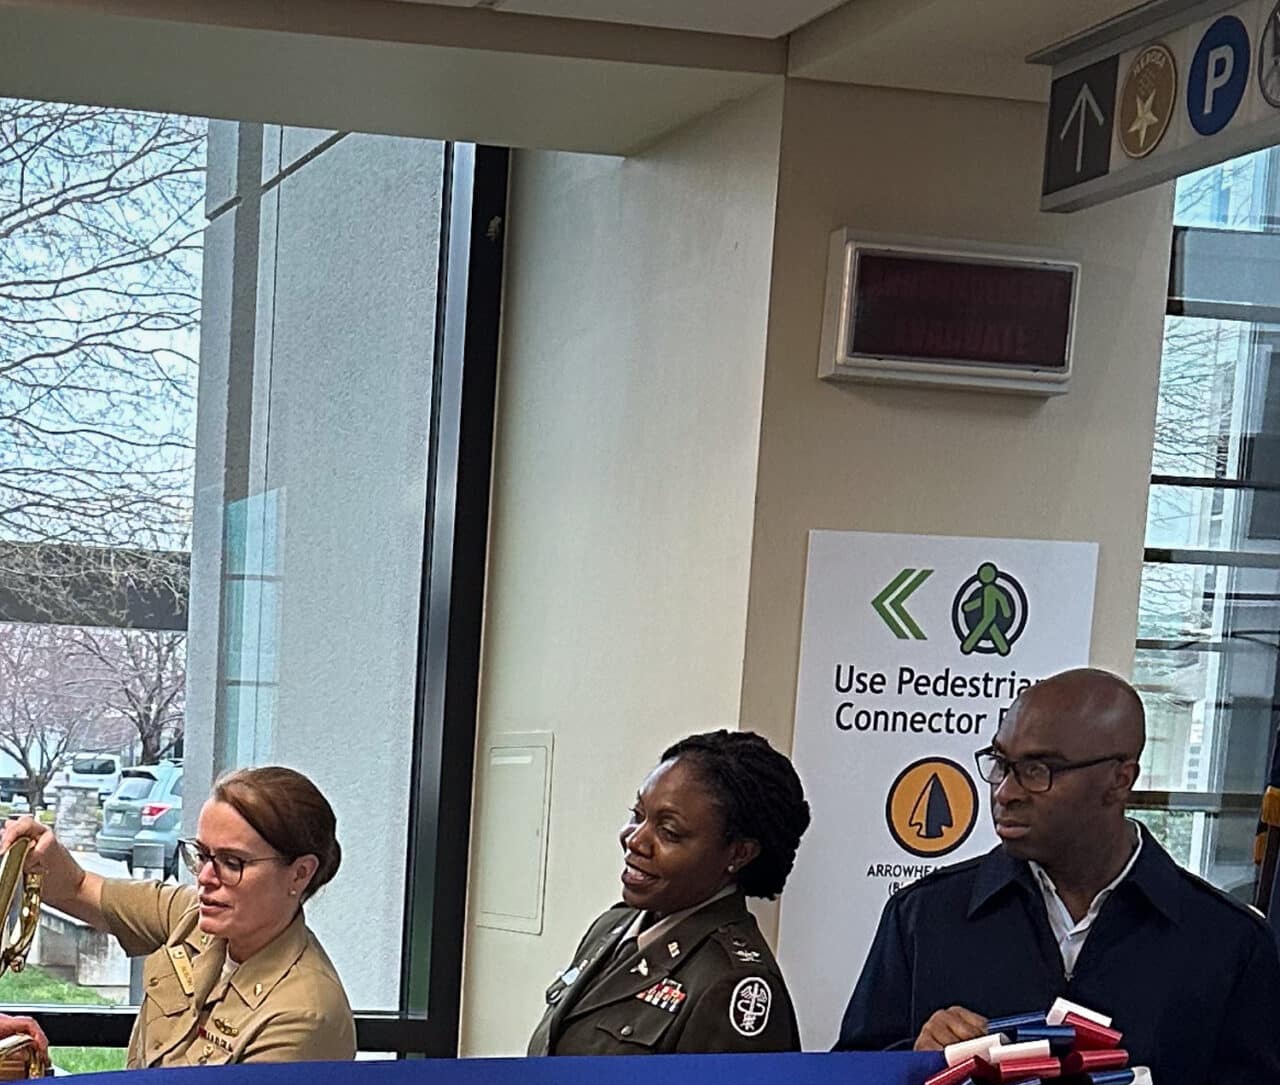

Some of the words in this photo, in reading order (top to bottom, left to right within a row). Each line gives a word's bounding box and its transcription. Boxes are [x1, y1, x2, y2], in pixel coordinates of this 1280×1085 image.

[1203, 44, 1236, 116] P
[835, 664, 887, 695] Use
[898, 667, 1046, 699] Pedestria
[835, 702, 988, 735] Connector
